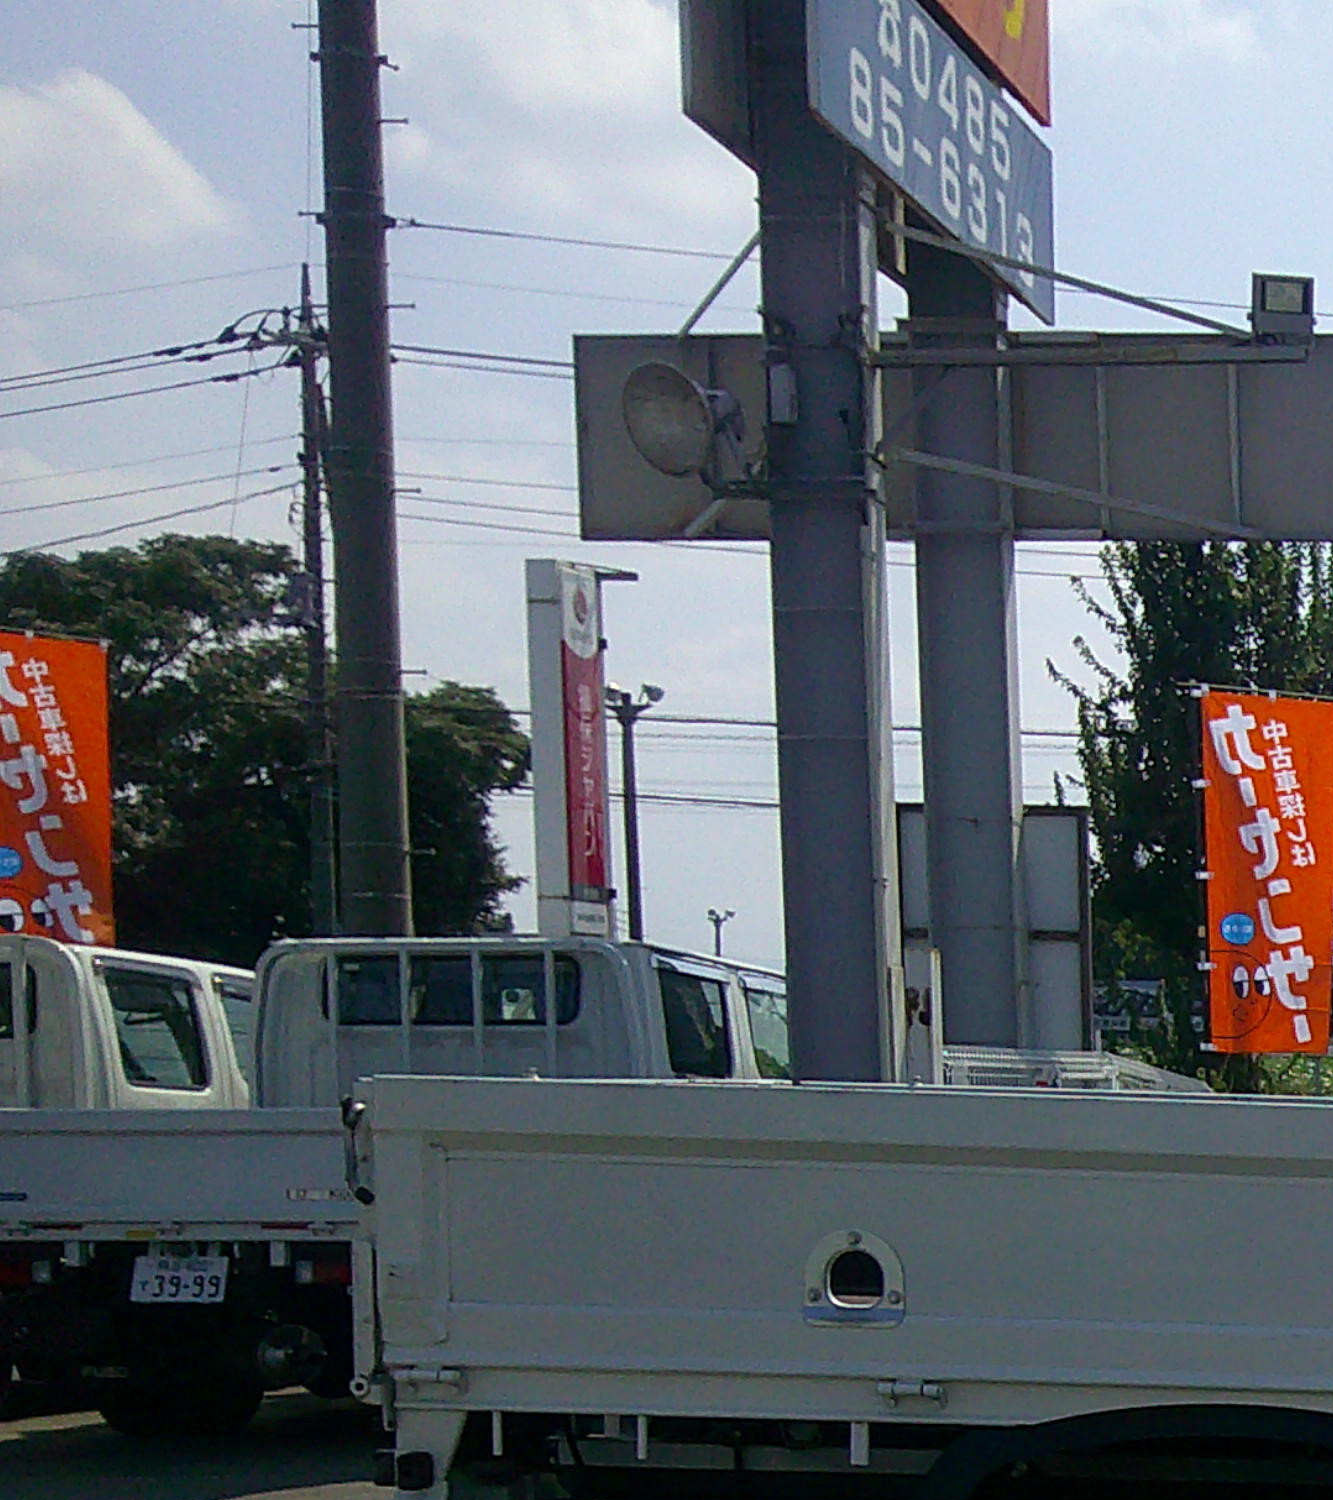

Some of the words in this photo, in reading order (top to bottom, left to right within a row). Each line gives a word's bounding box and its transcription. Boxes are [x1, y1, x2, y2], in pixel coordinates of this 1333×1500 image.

[849, 47, 1035, 289] 85-6313
[909, 15, 1011, 181] 0485
[152, 1274, 222, 1298] 39-99
